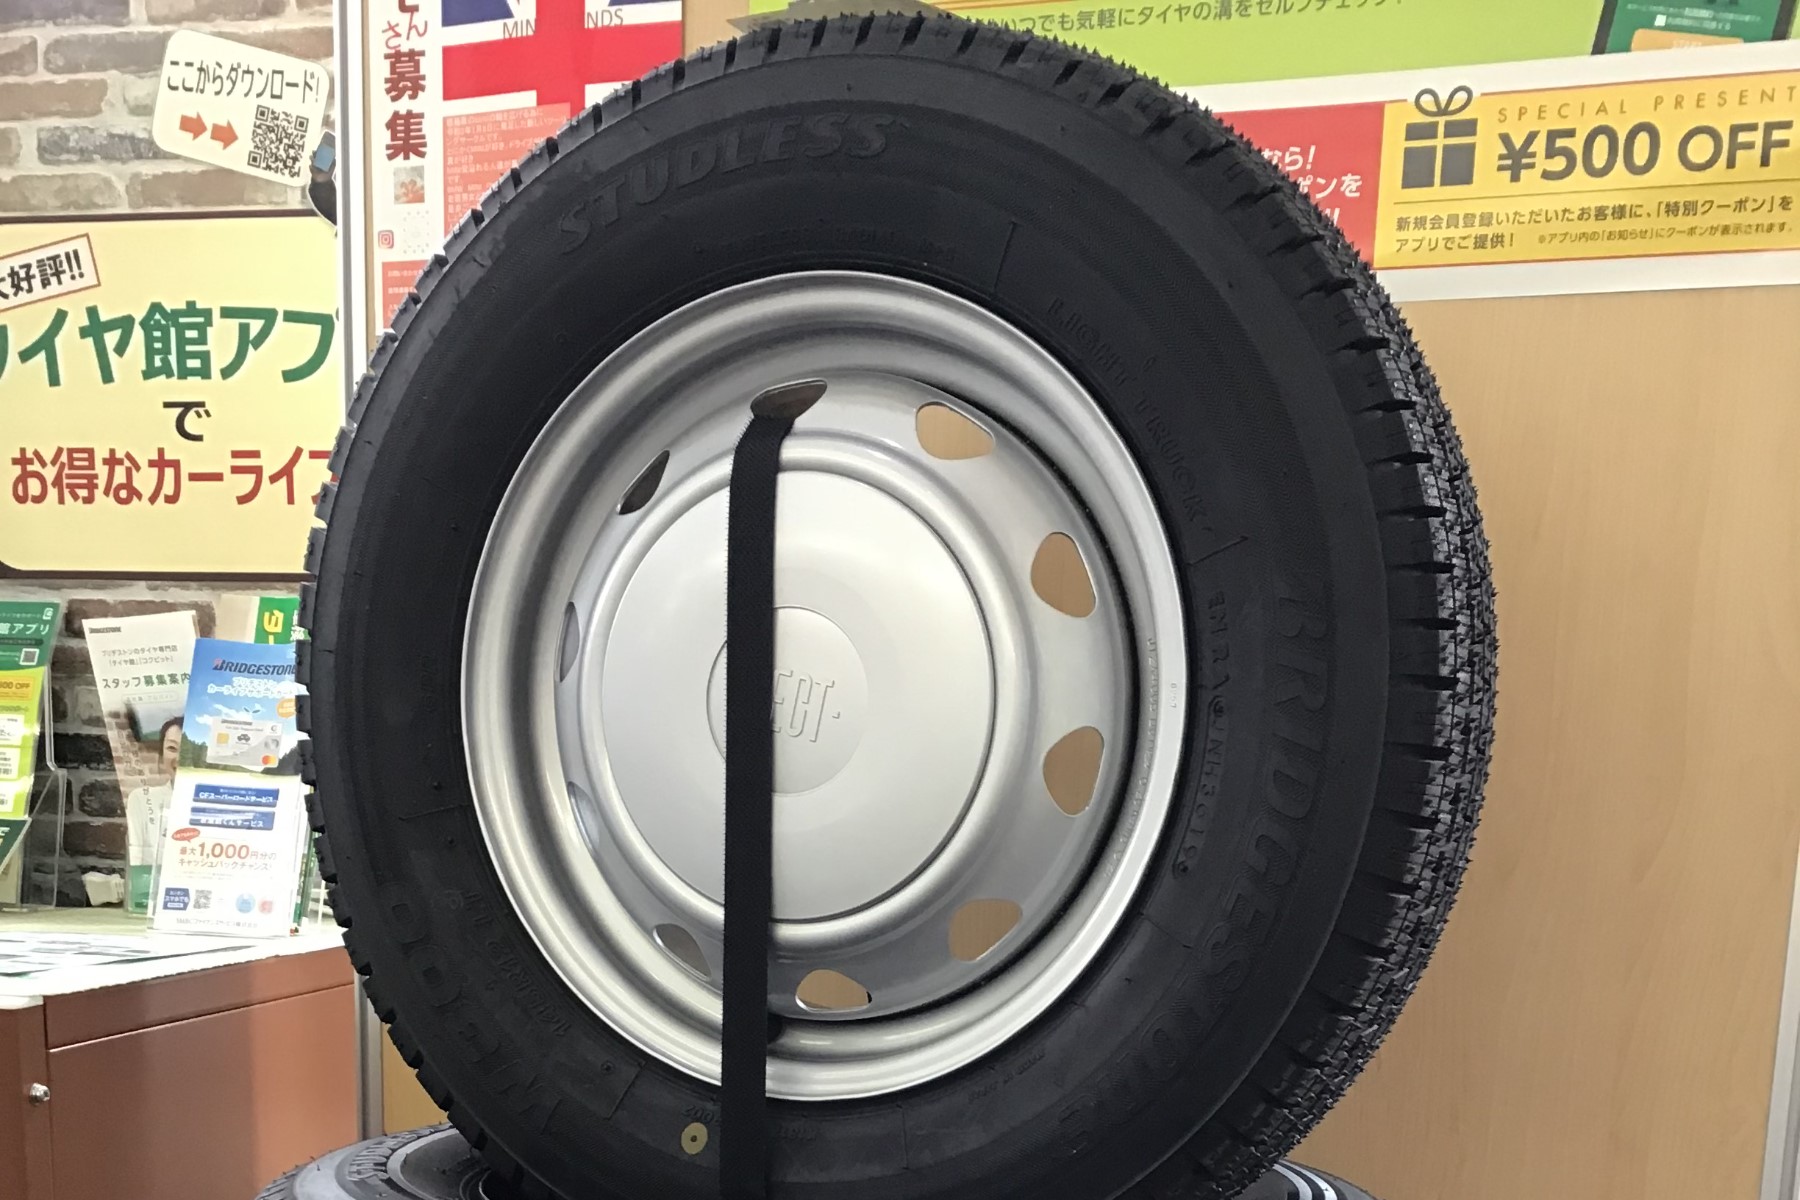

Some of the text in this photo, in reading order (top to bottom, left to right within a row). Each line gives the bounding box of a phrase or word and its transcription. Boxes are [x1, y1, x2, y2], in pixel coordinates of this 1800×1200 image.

[167, 59, 320, 104] ここからダウンロード!
[1498, 84, 1799, 124] SPECIAL PRESENT
[1497, 119, 1794, 183] ¥500 OFF
[560, 112, 897, 255] STUDLESS
[162, 400, 212, 442] で
